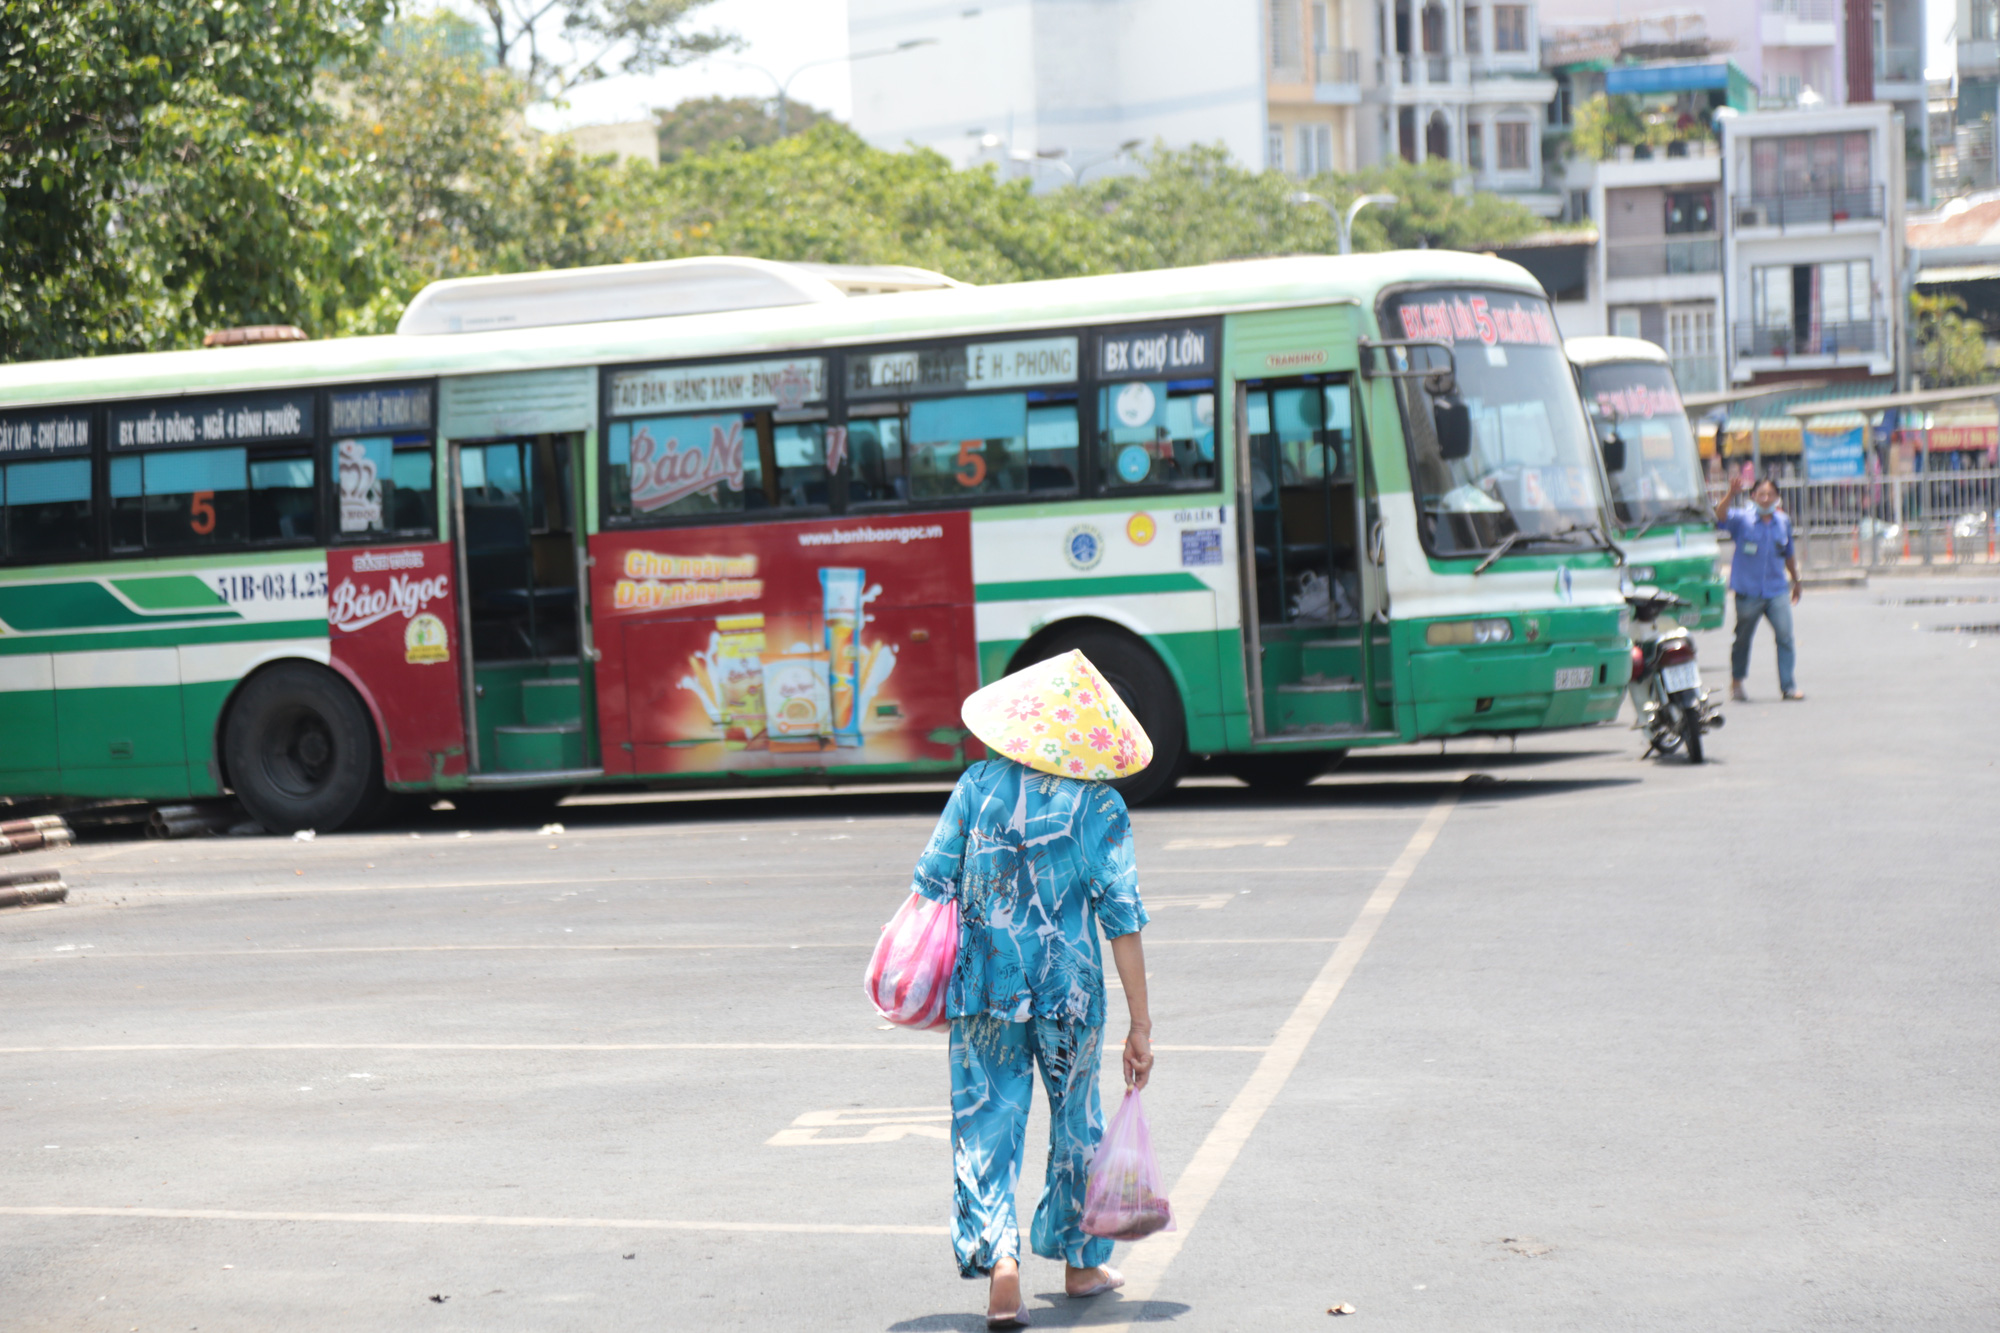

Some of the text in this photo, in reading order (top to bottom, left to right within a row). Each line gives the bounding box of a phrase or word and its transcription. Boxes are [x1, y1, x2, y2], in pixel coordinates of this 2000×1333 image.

[1470, 294, 1498, 346] 5
[1106, 328, 1205, 374] BX CHỢ LỚN
[711, 374, 745, 399] XANH
[38, 418, 56, 453] CHỢ
[76, 419, 88, 447] AN
[119, 420, 134, 446] BX
[165, 411, 195, 442] ĐÔNG
[203, 408, 224, 440] NGÃ
[227, 413, 235, 438] 4
[236, 406, 262, 438] BÌNH
[956, 440, 986, 486] 5
[191, 490, 215, 534] 5
[799, 525, 942, 546] www.banhbaongoc.vn
[624, 549, 673, 579] Cho
[328, 572, 449, 632] Bảo Ngọc
